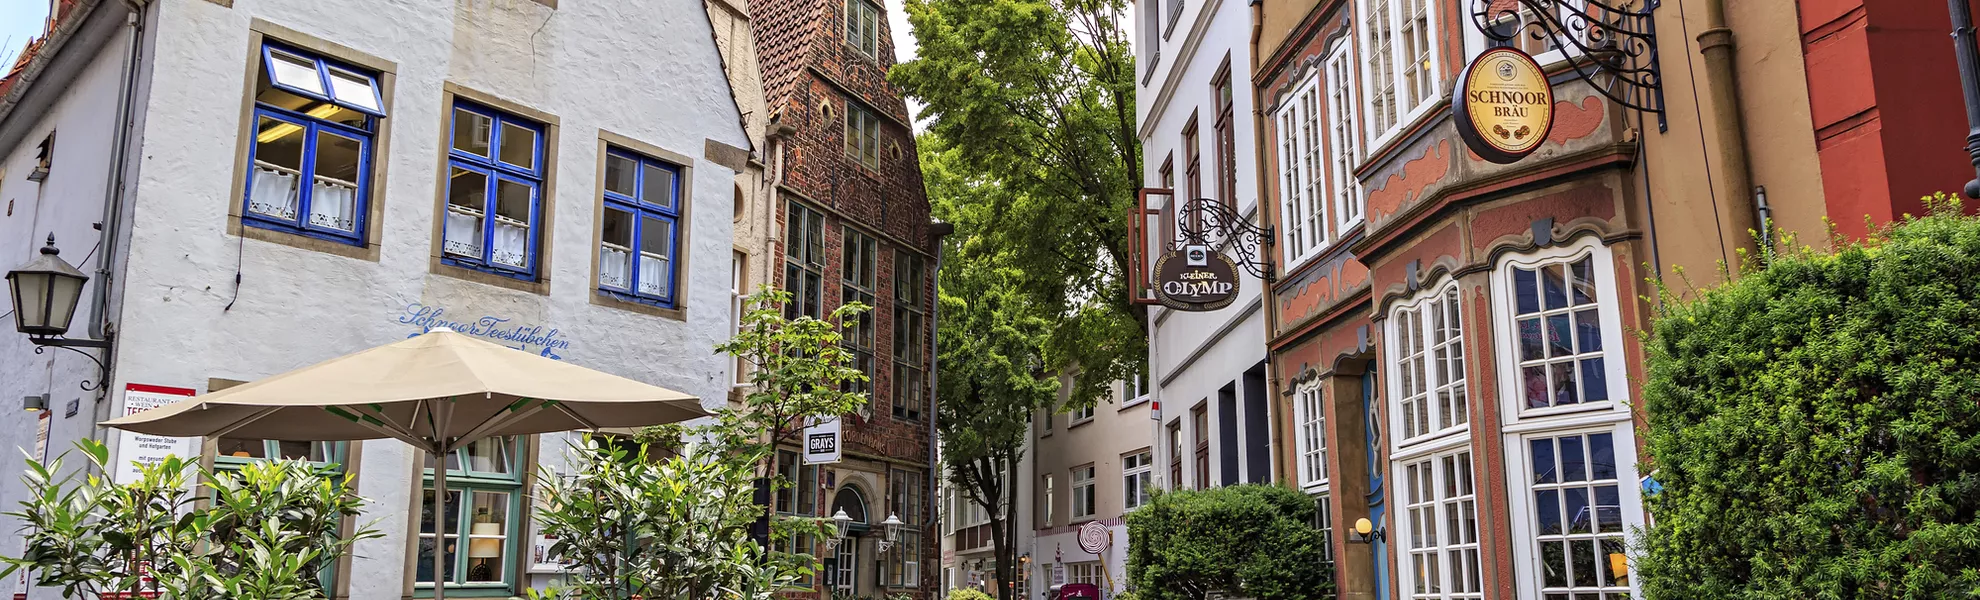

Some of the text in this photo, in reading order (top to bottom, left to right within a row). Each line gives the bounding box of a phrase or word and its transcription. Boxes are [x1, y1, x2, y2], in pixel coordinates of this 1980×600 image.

[1470, 90, 1547, 105] SCHNOOR
[1494, 105, 1528, 117] BRÄU
[128, 396, 170, 404] RESTAURANT
[810, 437, 834, 450] GRAYS
